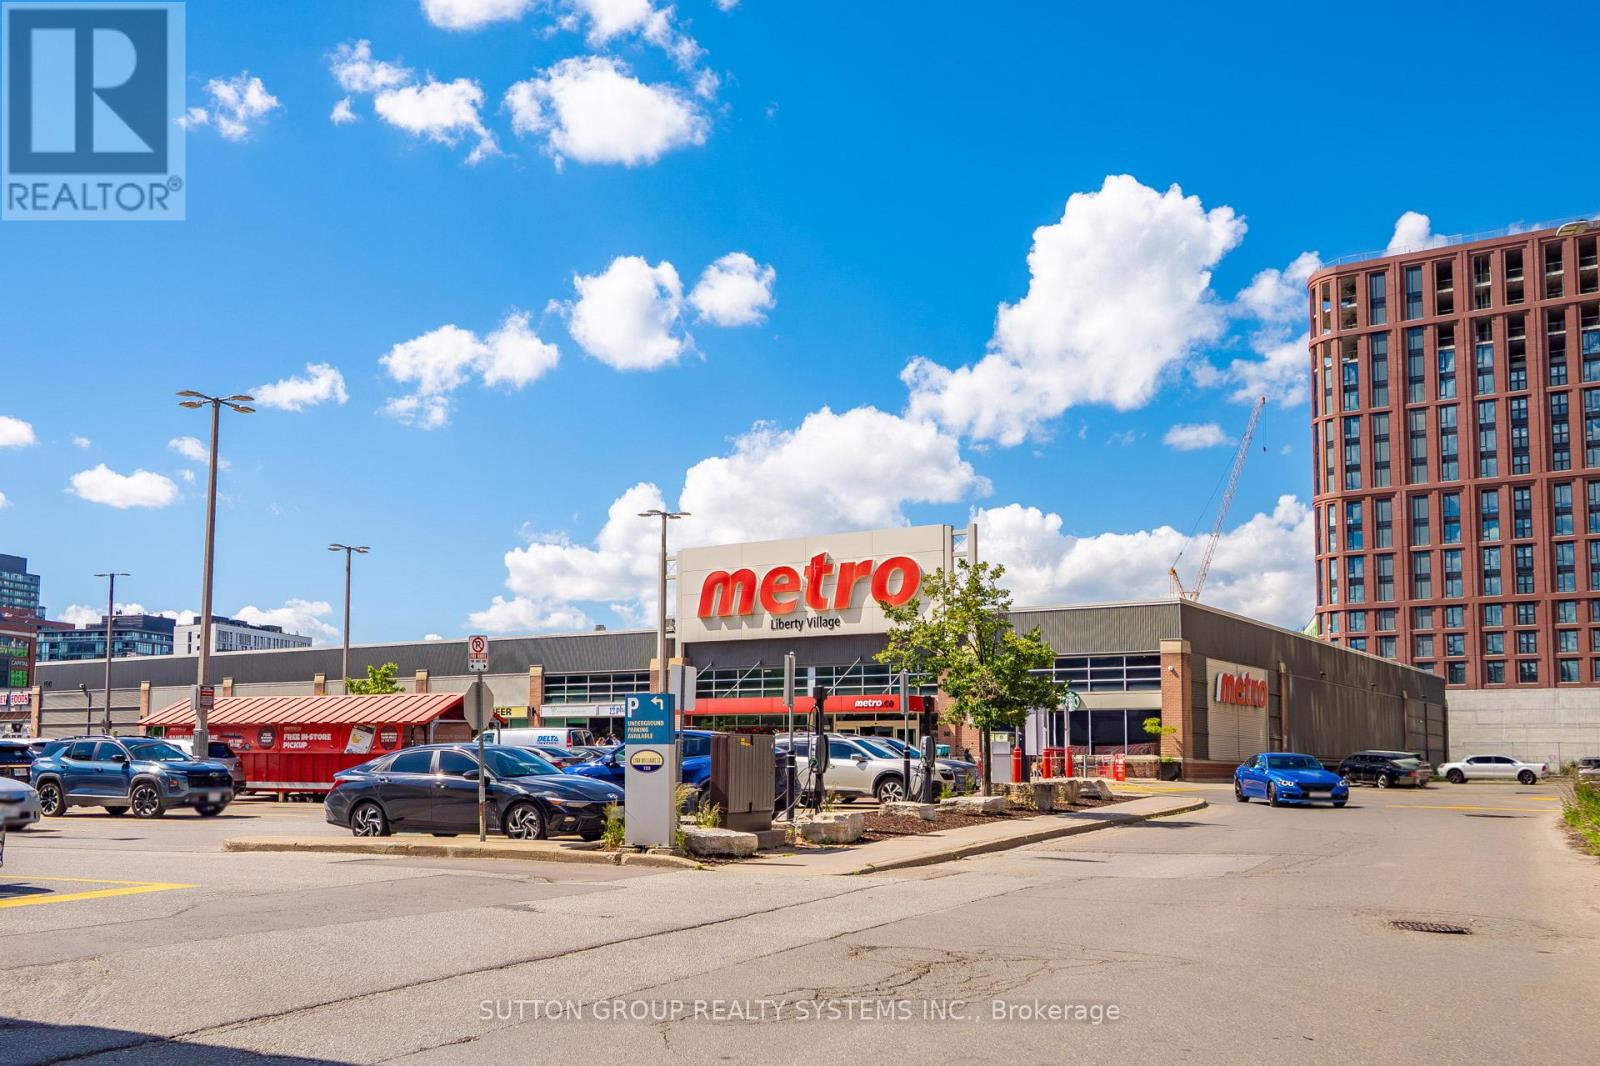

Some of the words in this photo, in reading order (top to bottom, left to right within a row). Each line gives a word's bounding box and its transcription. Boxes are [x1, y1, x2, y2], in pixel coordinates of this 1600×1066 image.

[697, 552, 921, 618] metro
[770, 618, 804, 632] Liberty
[806, 616, 841, 631] Village
[1216, 671, 1268, 708] metro
[627, 697, 639, 718] P
[282, 741, 308, 749] PICKUP
[283, 732, 300, 741] FREE
[301, 733, 332, 741] IN-STORE
